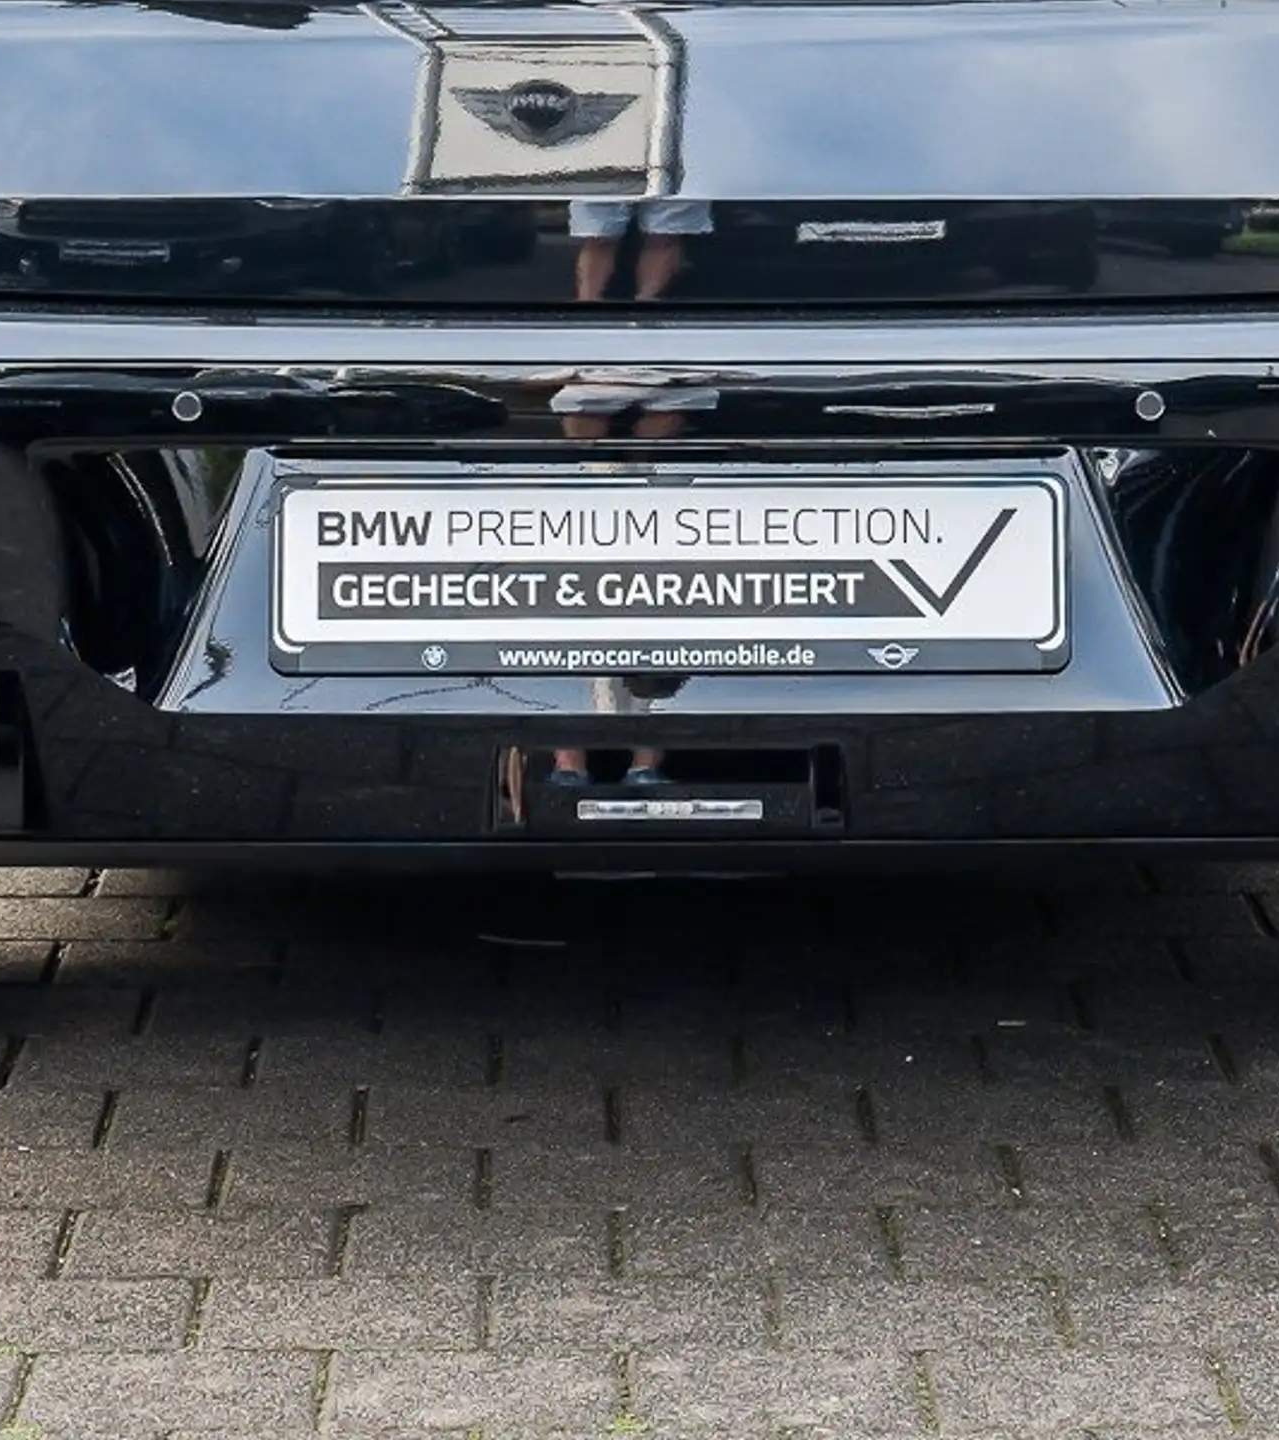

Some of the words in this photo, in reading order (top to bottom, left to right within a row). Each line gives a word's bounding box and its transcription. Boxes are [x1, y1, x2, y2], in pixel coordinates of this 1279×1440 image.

[317, 510, 432, 547] BMW
[447, 509, 659, 547] PREMIUM
[675, 508, 944, 547] SELECTION.
[332, 573, 547, 608] GECHECKT
[554, 572, 587, 608] &
[596, 572, 865, 607] GARANTIERT
[498, 643, 816, 669] www.procar-automobile.de
